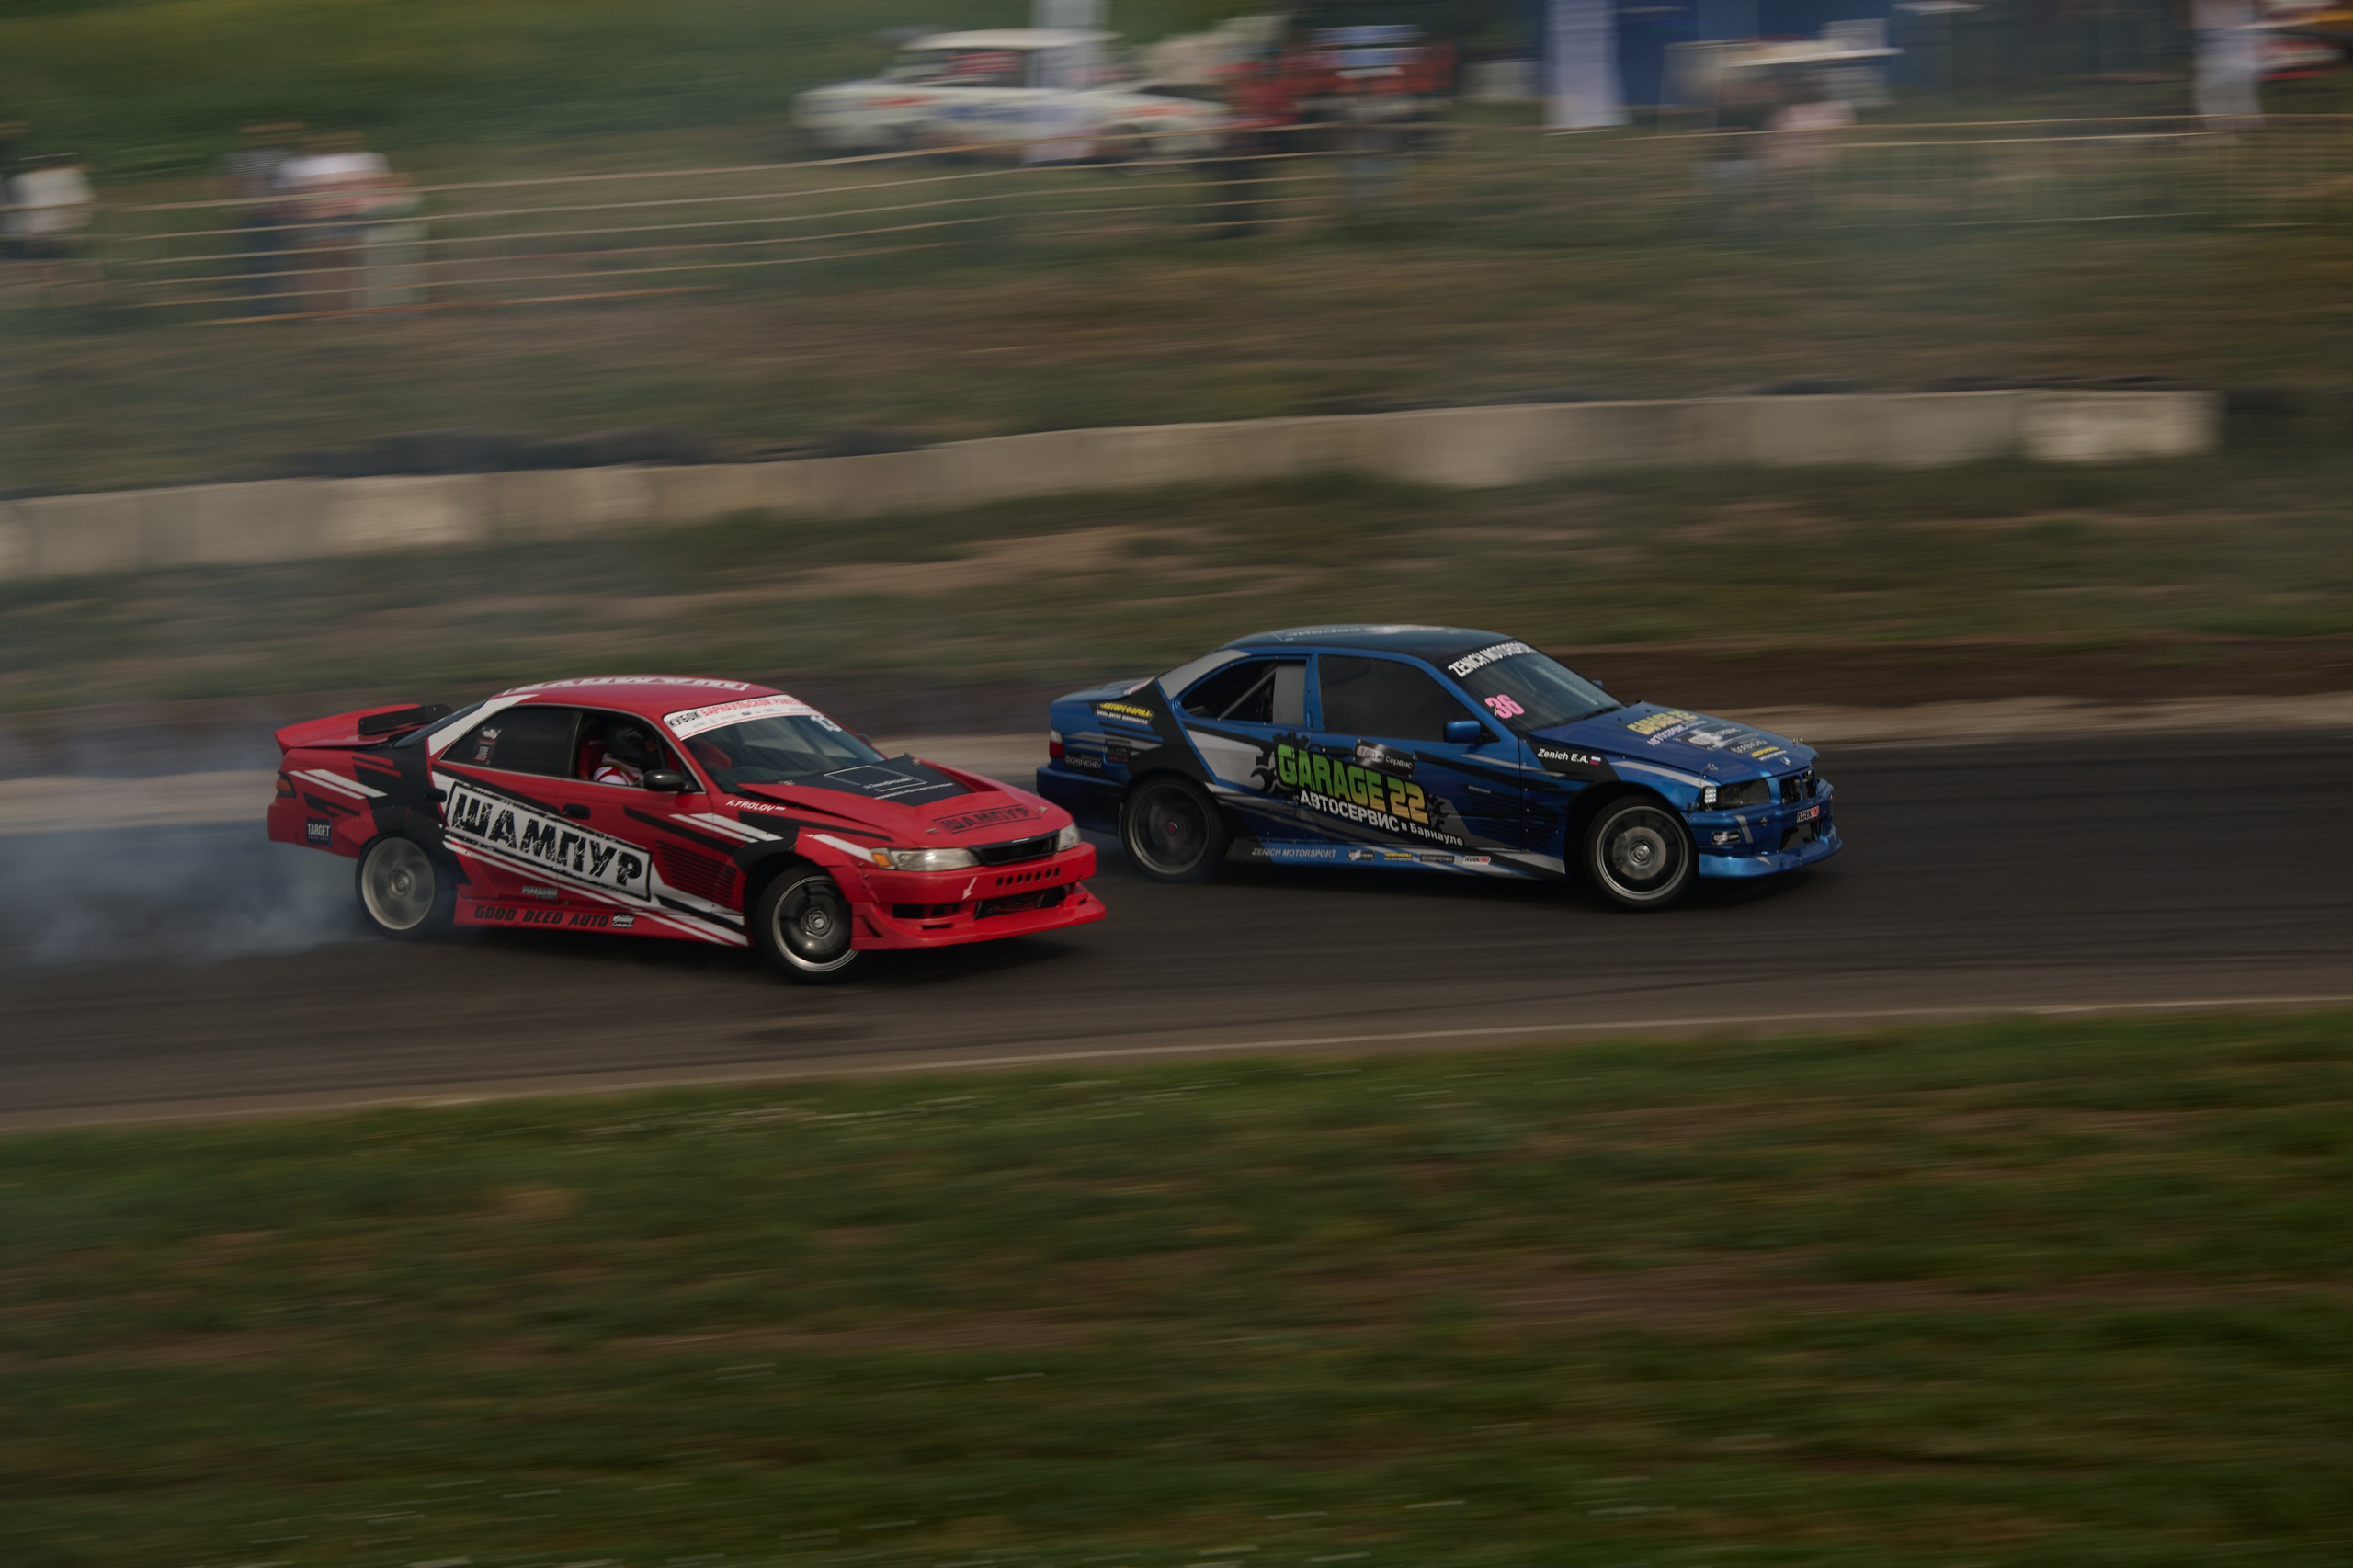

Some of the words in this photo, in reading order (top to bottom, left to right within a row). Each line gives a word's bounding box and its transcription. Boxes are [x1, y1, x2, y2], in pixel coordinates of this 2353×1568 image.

[1483, 693, 1525, 719] 36
[1385, 756, 1413, 770] сервис
[1537, 747, 1569, 762] Zenich
[1570, 753, 1589, 765] E.A.
[1277, 744, 1387, 812] GARAGE
[1386, 775, 1429, 825] 22
[725, 799, 776, 812] A.FROLOV
[1299, 790, 1401, 833] АВТОСЕРВИС
[1401, 821, 1408, 831] в
[1409, 823, 1464, 846] Барнауле
[307, 823, 331, 837] TARGET
[451, 792, 643, 887] ШАМПУР
[1251, 847, 1281, 857] ZENICH
[1281, 848, 1337, 859] MOTORSPORT
